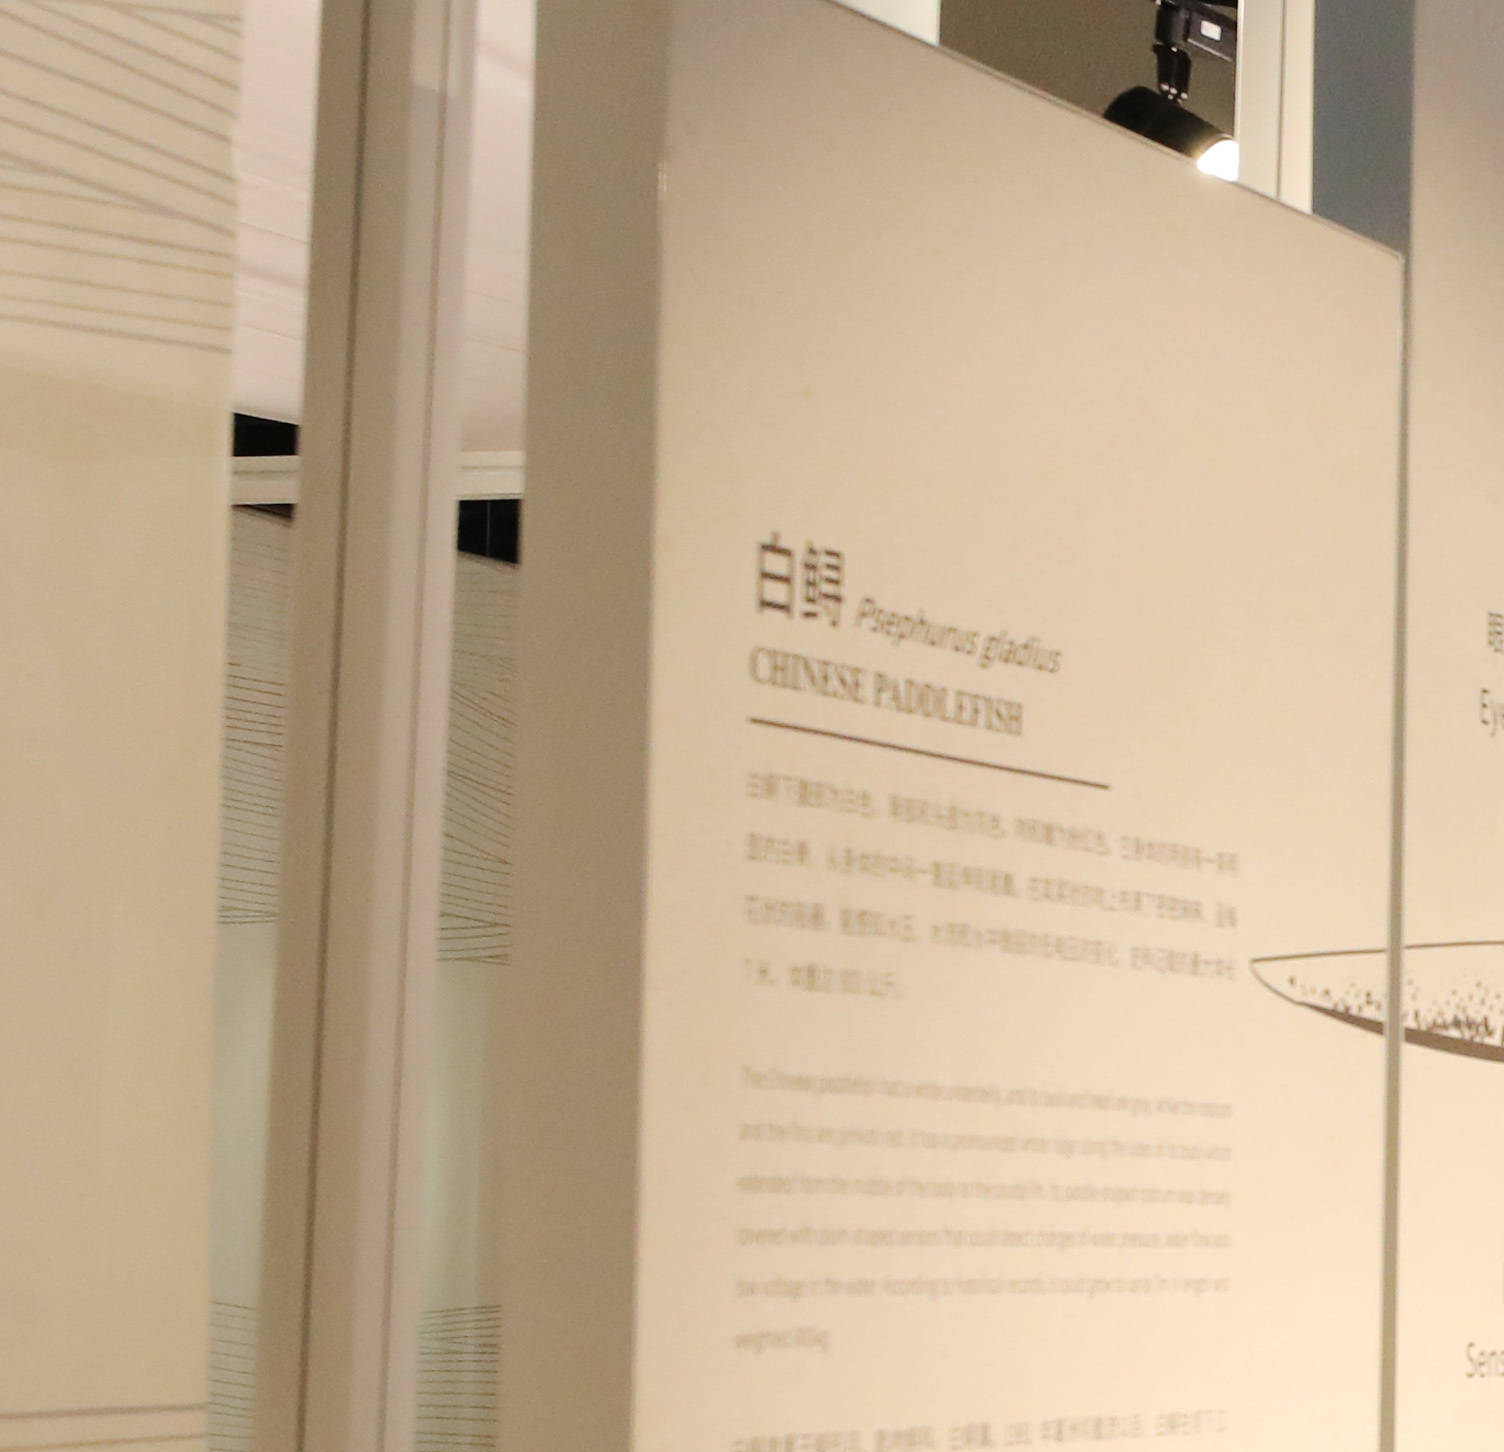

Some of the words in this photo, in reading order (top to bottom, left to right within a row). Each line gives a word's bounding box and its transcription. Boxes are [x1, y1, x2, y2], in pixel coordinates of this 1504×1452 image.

[854, 597, 979, 656] Psephurus
[980, 630, 1062, 674] gladius
[749, 645, 868, 705] CHINESE
[873, 670, 1024, 736] PADDLEFISH
